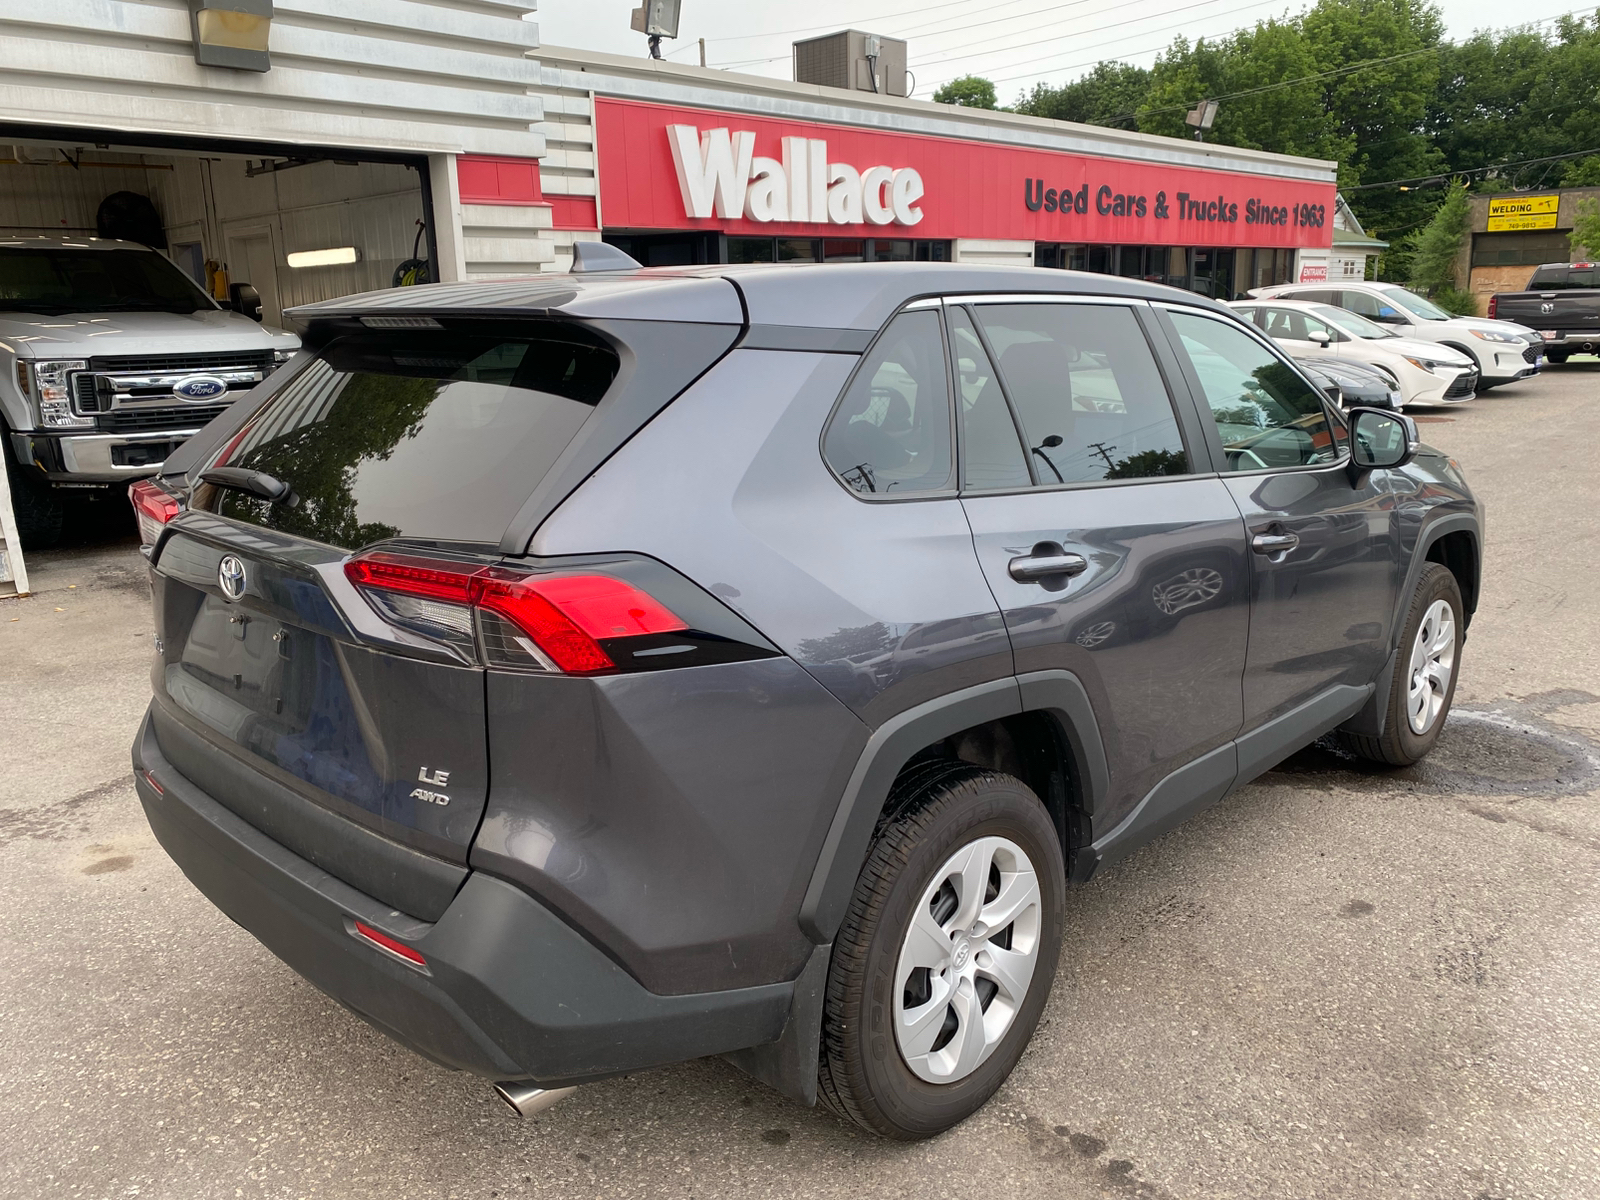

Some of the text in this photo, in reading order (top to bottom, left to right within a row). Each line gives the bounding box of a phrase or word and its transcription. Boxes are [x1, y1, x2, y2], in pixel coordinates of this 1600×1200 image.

[665, 124, 925, 226] Wallace
[1025, 178, 1326, 228] Used Cars & Trucks Since 1963
[1492, 204, 1532, 214] WELDING
[1304, 267, 1327, 276] ENTRANCE
[189, 382, 215, 395] Ford
[418, 766, 450, 787] LE
[409, 788, 450, 806] AWD
[871, 940, 896, 1061] OPEN
